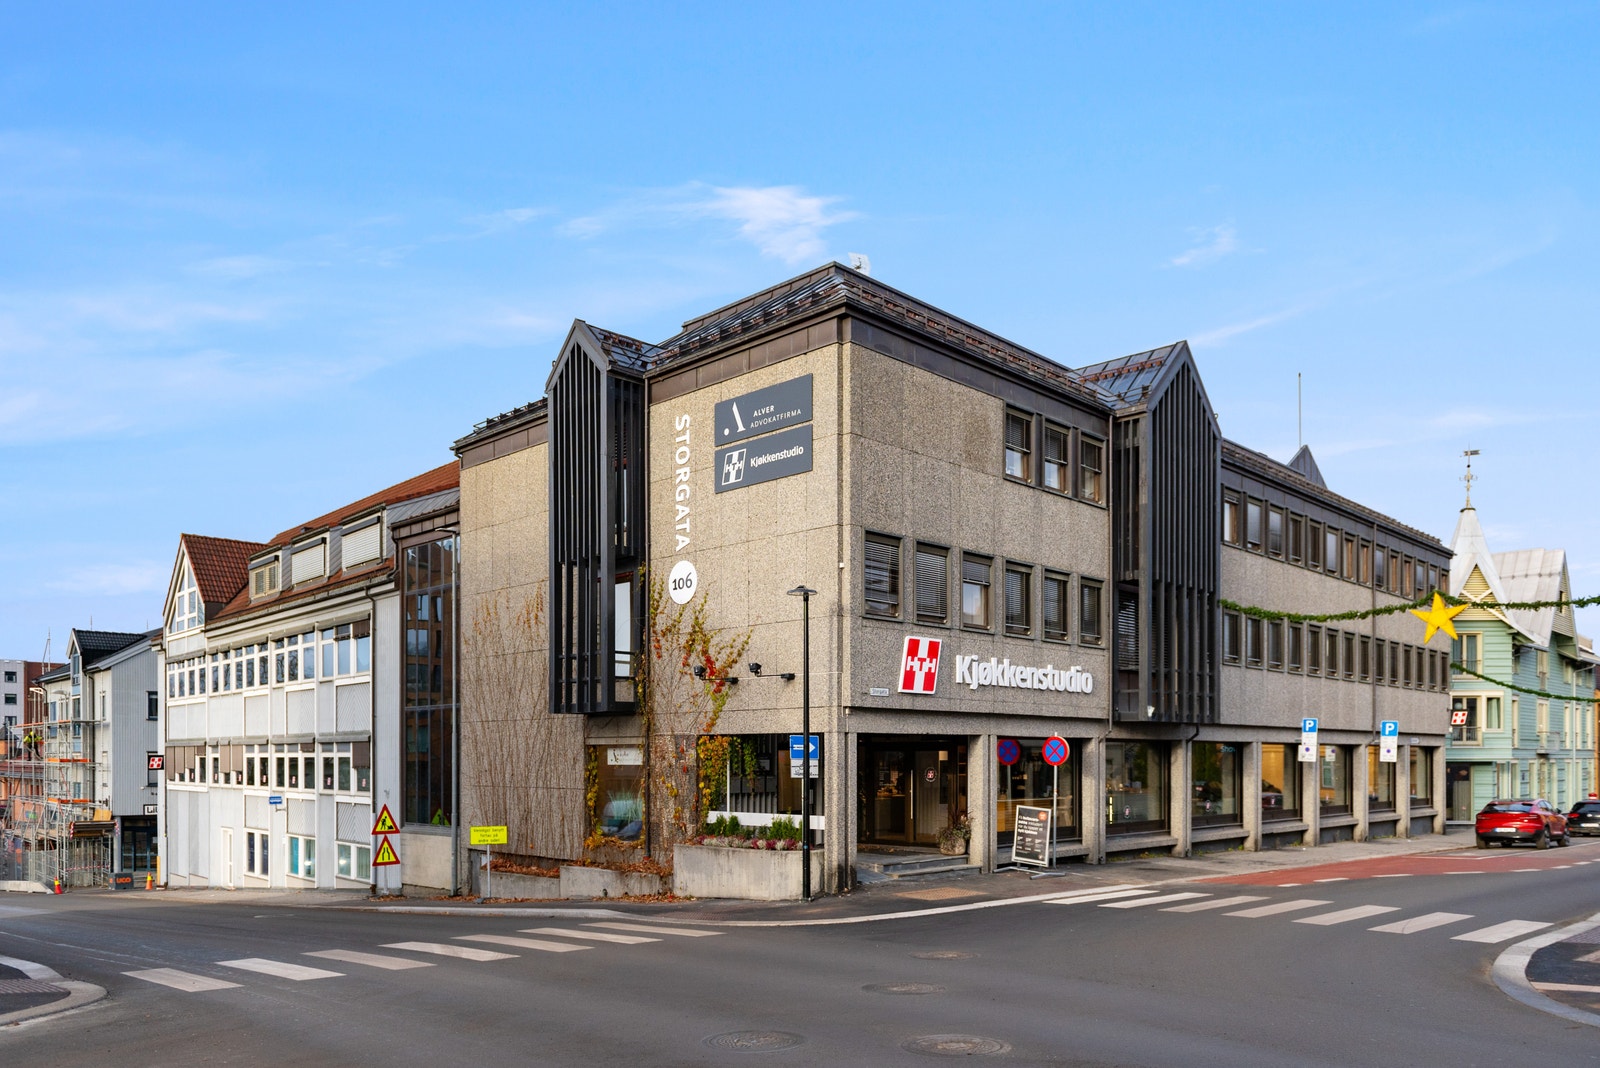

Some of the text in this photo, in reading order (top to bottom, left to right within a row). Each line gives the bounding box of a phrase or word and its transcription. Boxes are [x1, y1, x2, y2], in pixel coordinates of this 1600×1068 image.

[750, 409, 802, 428] ADVOKATFIRMA
[753, 405, 775, 418] ALVER
[750, 446, 804, 468] Kjøkkenstudio
[675, 413, 690, 552] STORGATA
[672, 573, 692, 590] 106
[955, 654, 1093, 694] Kjøkkenstudio
[1306, 720, 1314, 732] P
[1385, 722, 1395, 735] P
